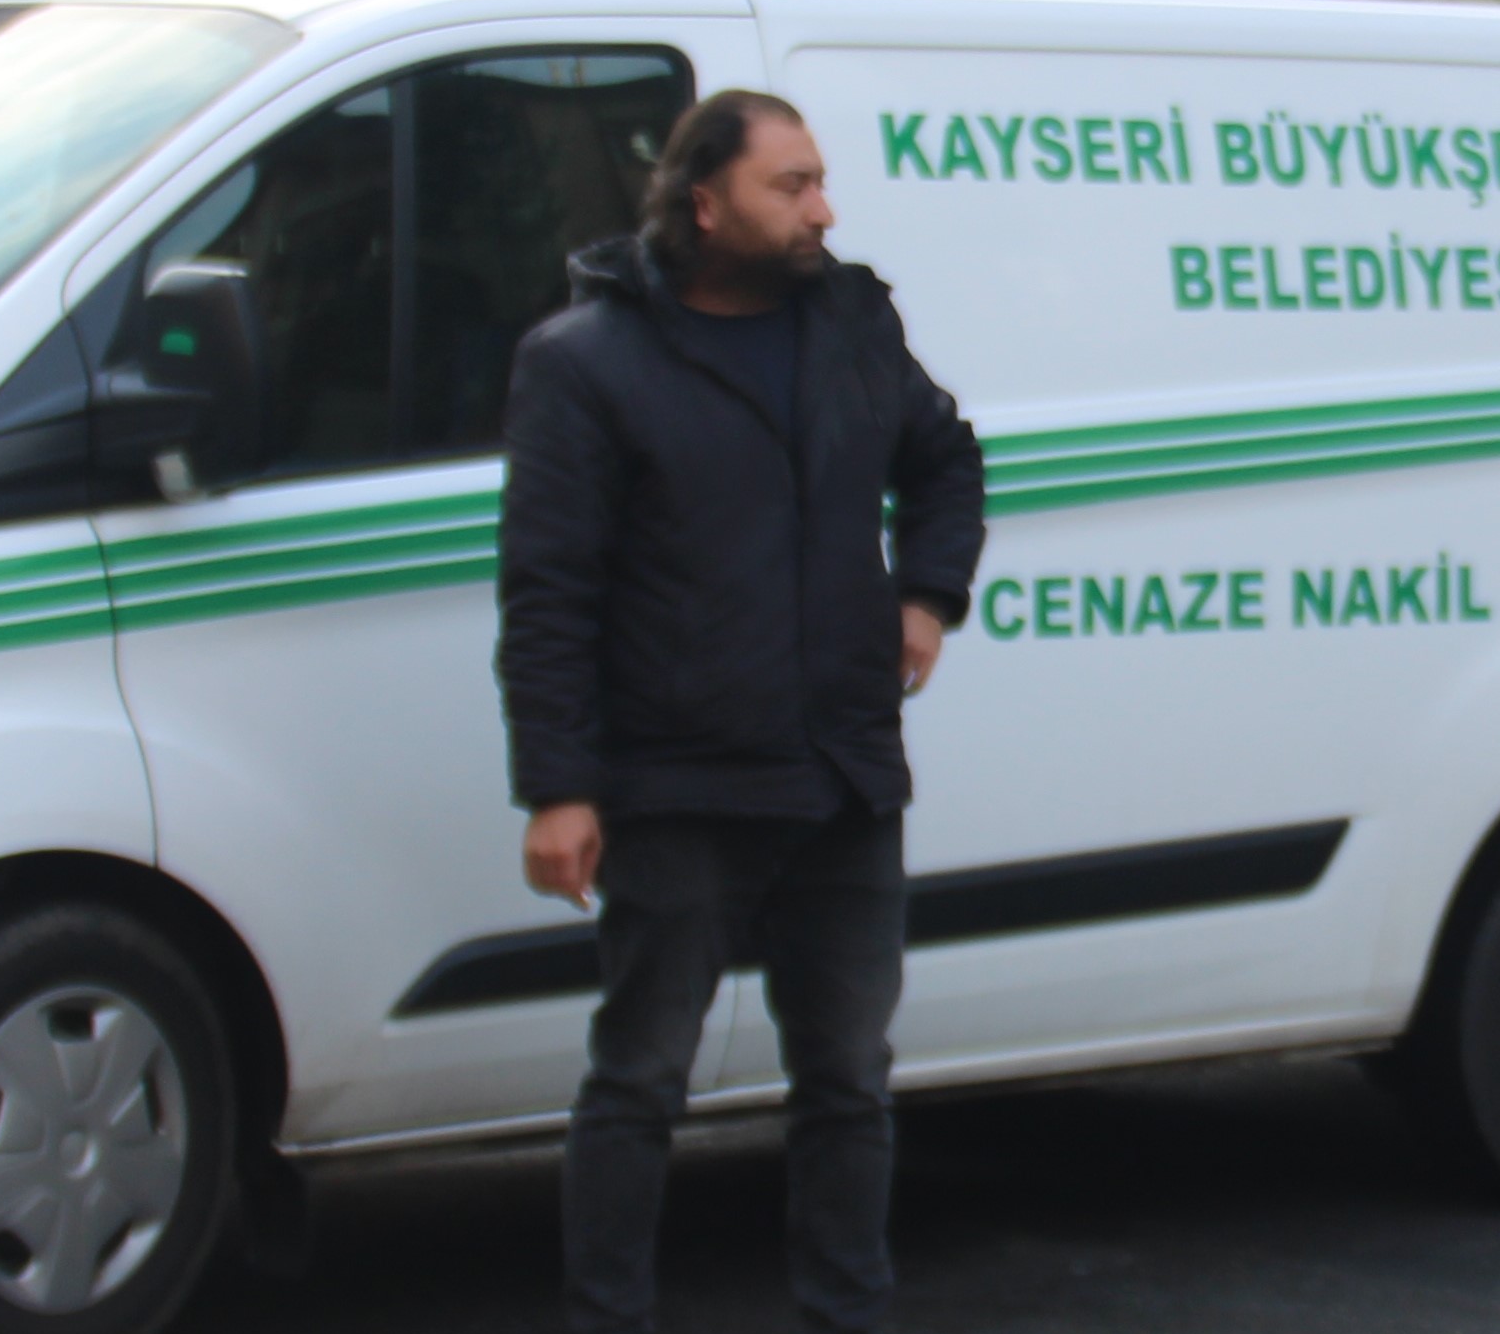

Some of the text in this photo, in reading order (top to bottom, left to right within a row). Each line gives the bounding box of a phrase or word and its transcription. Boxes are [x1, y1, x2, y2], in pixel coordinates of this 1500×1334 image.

[878, 105, 1192, 185] KAYSERİ
[980, 569, 1267, 643] CENAZE
[1291, 550, 1492, 629] NAKİL
